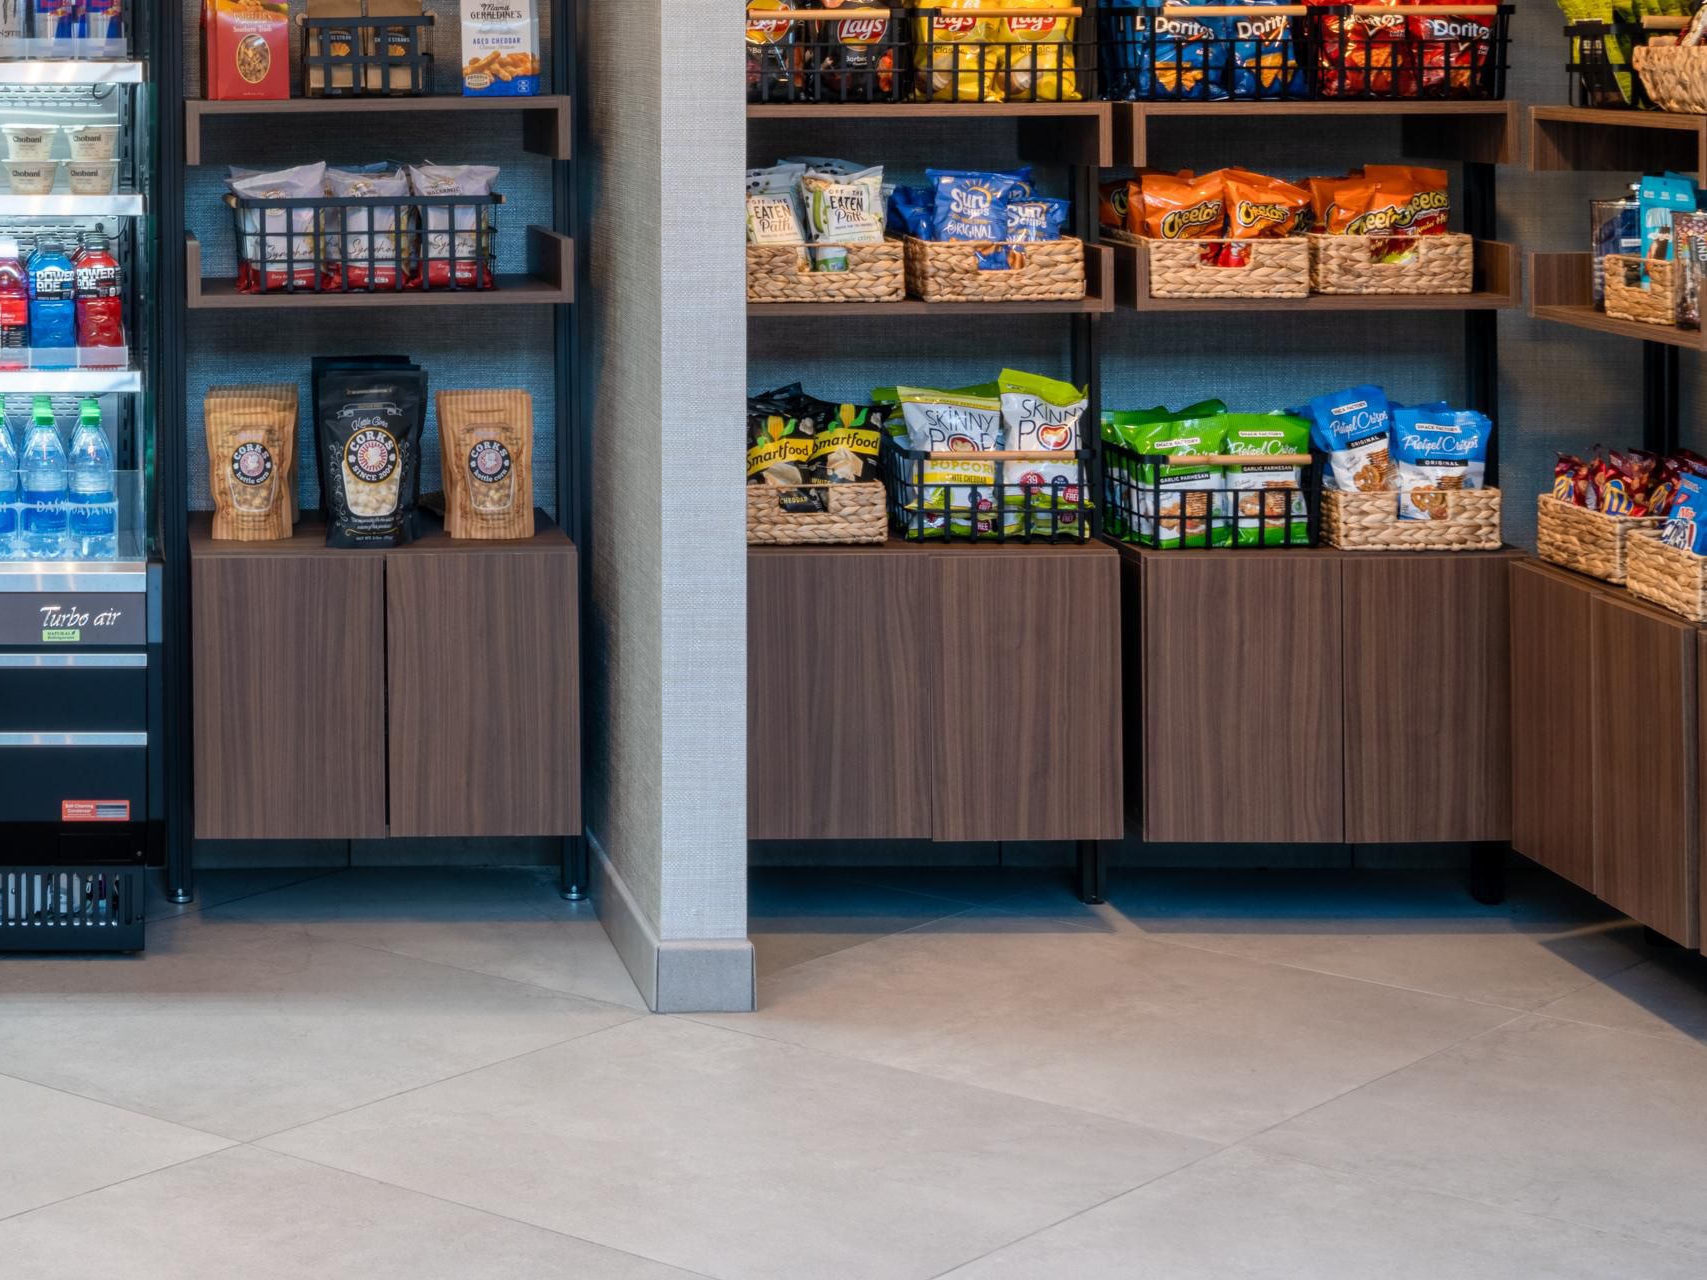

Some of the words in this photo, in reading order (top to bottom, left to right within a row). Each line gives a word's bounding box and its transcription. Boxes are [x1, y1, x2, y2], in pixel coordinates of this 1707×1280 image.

[1433, 19, 1491, 40] Dorito
[472, 37, 489, 45] AGED
[491, 37, 521, 45] CHEDDAR
[12, 135, 42, 144] Chobani
[72, 134, 102, 143] Chobani
[12, 169, 41, 178] Chobani
[70, 169, 99, 178] Chobani
[829, 195, 864, 212] EATEN
[950, 187, 991, 214] Sun
[753, 204, 792, 220] EATEN
[834, 209, 863, 224] Path
[962, 207, 991, 217] CHIPS
[1005, 203, 1046, 227] Sun
[759, 218, 793, 234] Path
[1019, 217, 1047, 229] CHIPS
[1162, 202, 1222, 239] Cheetos
[947, 220, 997, 239] ORIGINAL
[35, 269, 75, 282] POWER
[76, 267, 115, 280] POWER
[35, 281, 62, 293] ADE
[925, 406, 995, 432] SKINNY
[1329, 414, 1358, 439] Pretzel
[1357, 410, 1389, 430] Crisps
[349, 430, 395, 452] CORKS
[470, 440, 508, 458] CORKS
[812, 432, 879, 454] Smartfood
[1350, 435, 1380, 448] ORIGINAL
[1401, 433, 1441, 457] Pretzel
[1442, 435, 1479, 454] Crisps
[233, 443, 270, 460] CORKS
[746, 441, 810, 471] Smartfood
[256, 471, 270, 484] corn
[351, 464, 377, 482] SINCE
[378, 464, 393, 482] 2004
[473, 469, 493, 483] kettle
[493, 469, 508, 482] corn
[1159, 476, 1180, 484] GARLIC
[1180, 473, 1209, 483] PARMESAN
[39, 605, 90, 628] Turbo
[93, 607, 122, 627] air
